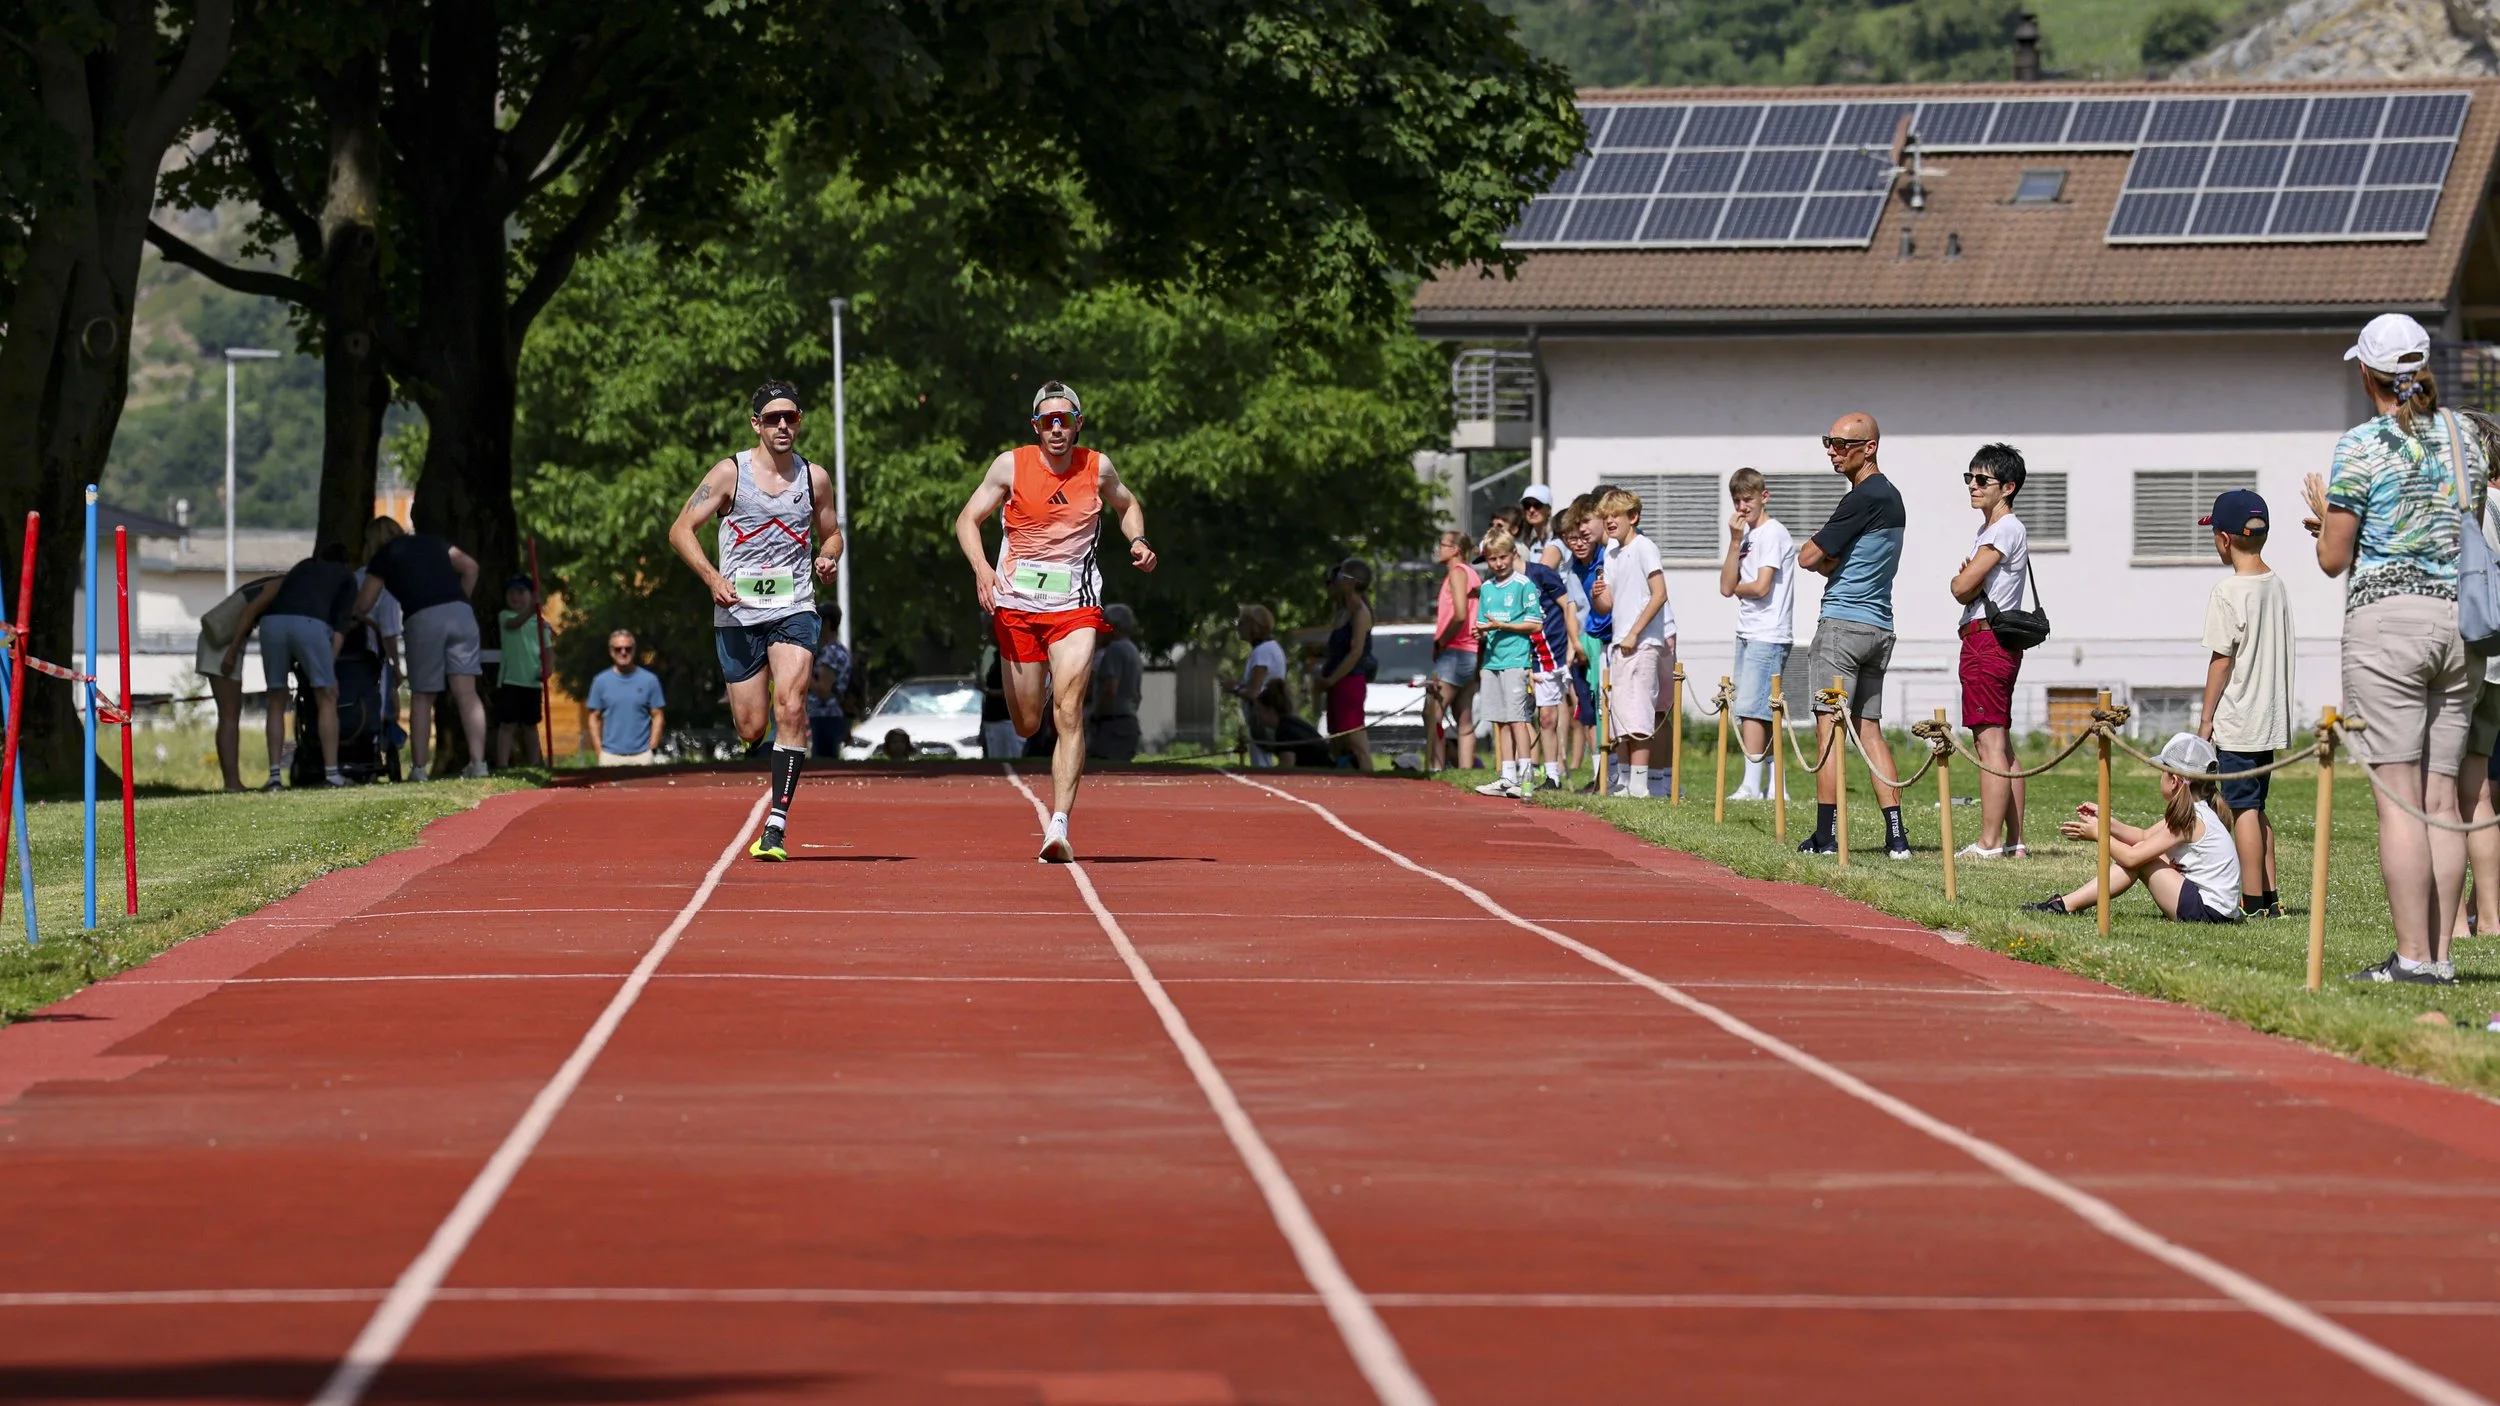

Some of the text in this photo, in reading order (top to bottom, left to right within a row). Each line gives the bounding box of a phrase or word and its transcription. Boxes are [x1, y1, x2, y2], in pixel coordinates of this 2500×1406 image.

[753, 579, 776, 595] 42
[1037, 572, 1048, 589] 7
[1889, 810, 1901, 838] DIRTYSOX
